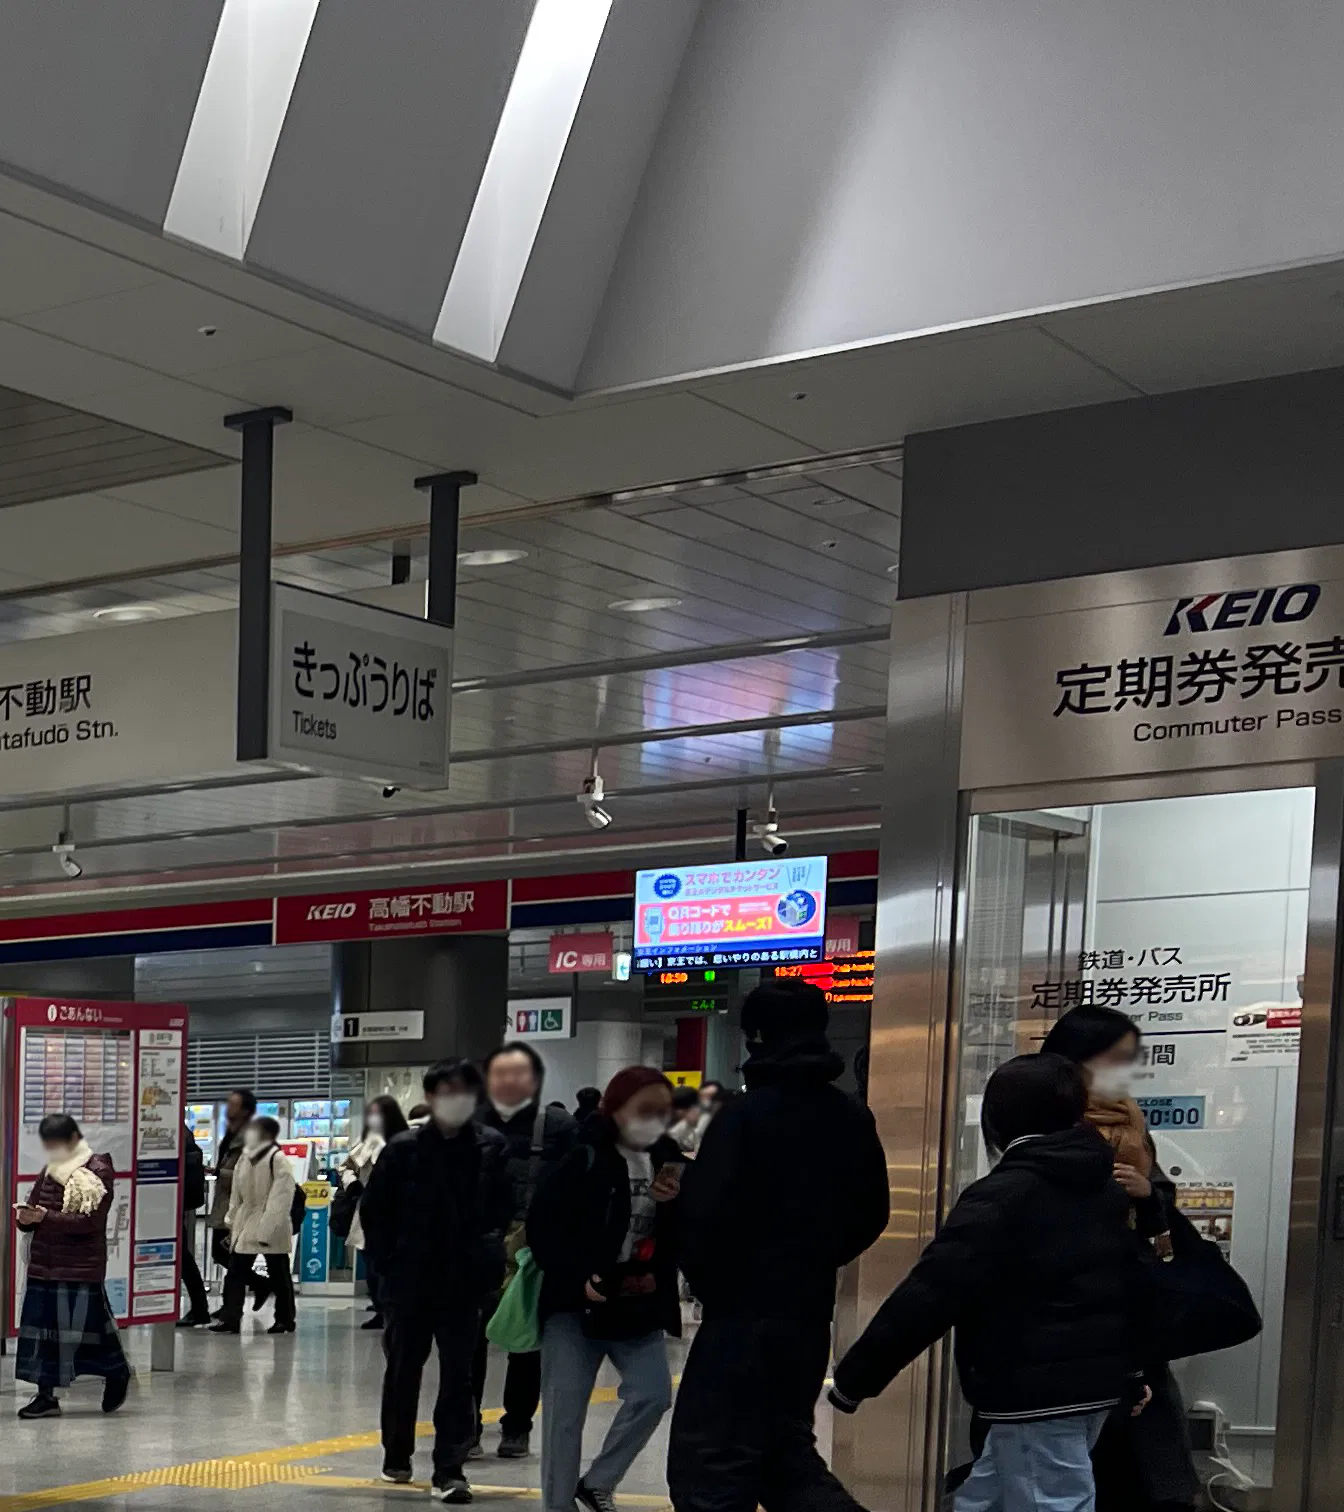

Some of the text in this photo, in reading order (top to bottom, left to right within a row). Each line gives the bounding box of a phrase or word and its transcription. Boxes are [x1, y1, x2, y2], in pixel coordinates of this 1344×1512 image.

[1163, 584, 1322, 637] KEIO
[293, 641, 438, 722] きっぷうりば
[75, 719, 120, 742] Stn.
[292, 710, 338, 740] Tickets
[1133, 706, 1343, 742] Commuter Pass
[306, 890, 475, 921] KEIO 高幡不動駅
[555, 950, 579, 969] IC
[1077, 947, 1184, 972] 鉄道・バス
[1029, 971, 1232, 1010] 定期券発売所
[1148, 1010, 1184, 1022] Pass
